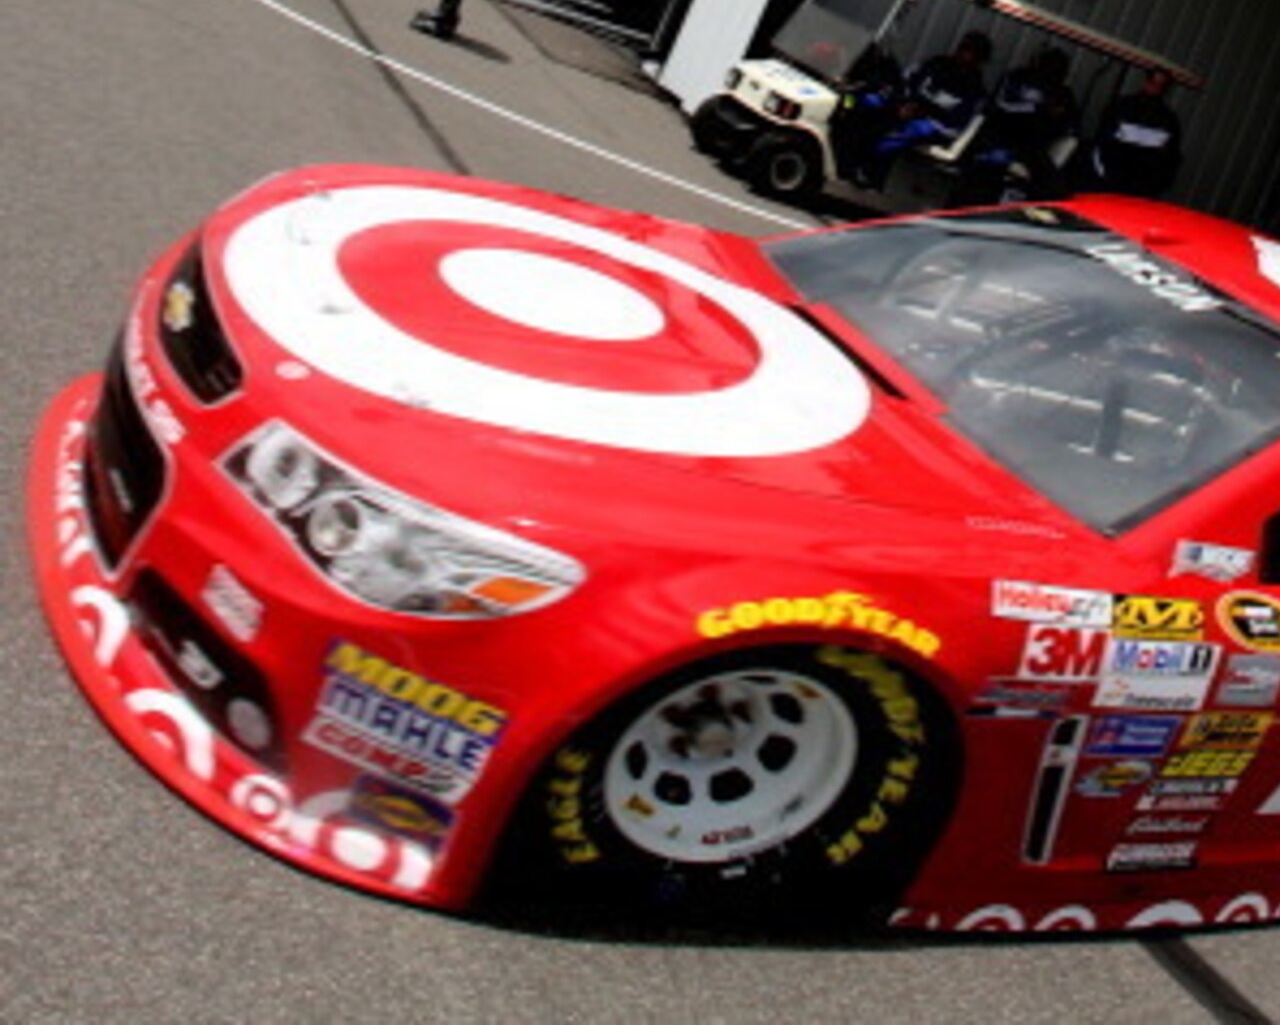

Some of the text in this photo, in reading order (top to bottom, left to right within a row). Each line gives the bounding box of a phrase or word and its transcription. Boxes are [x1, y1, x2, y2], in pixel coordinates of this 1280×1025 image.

[697, 590, 941, 659] GOODYEAR
[1025, 627, 1107, 676] 3M
[1112, 641, 1184, 672] Mobil
[326, 643, 509, 737] MOOG
[322, 677, 486, 773] MAHLE
